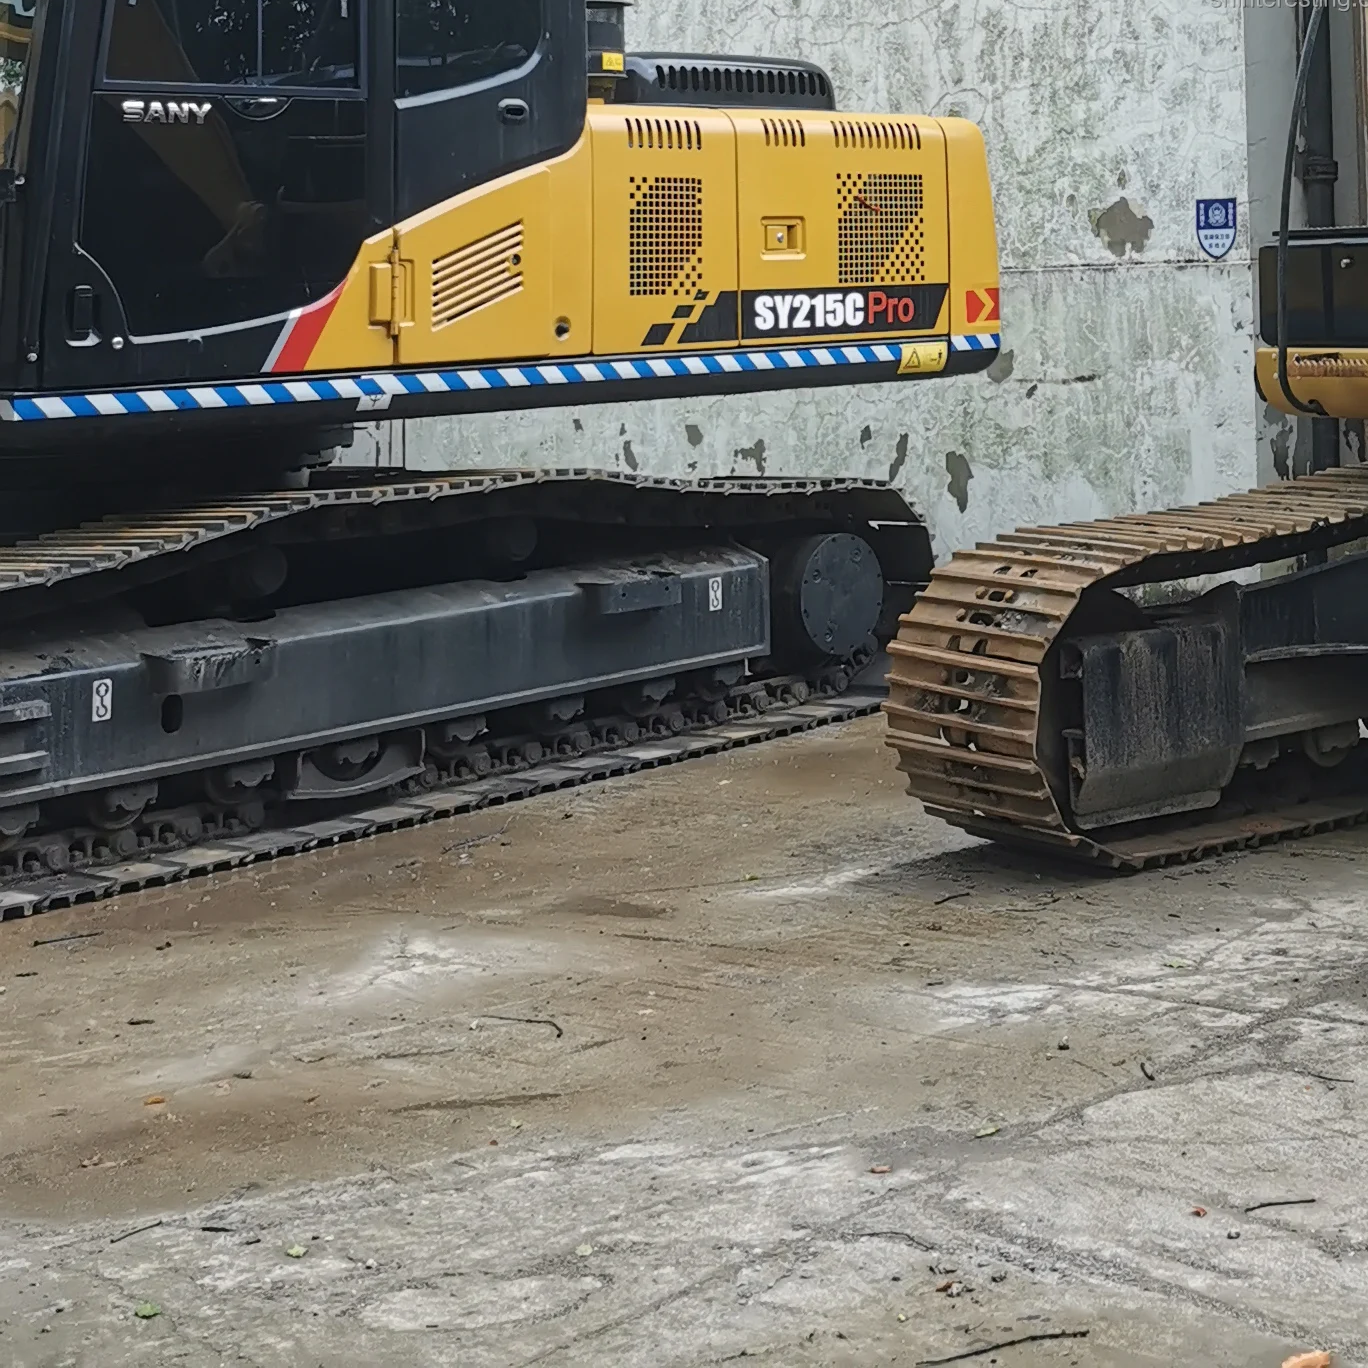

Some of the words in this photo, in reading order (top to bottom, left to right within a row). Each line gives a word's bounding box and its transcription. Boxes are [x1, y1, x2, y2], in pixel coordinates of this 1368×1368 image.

[122, 100, 213, 125] SANY
[754, 291, 866, 331] SY215C
[867, 290, 915, 325] Pro
